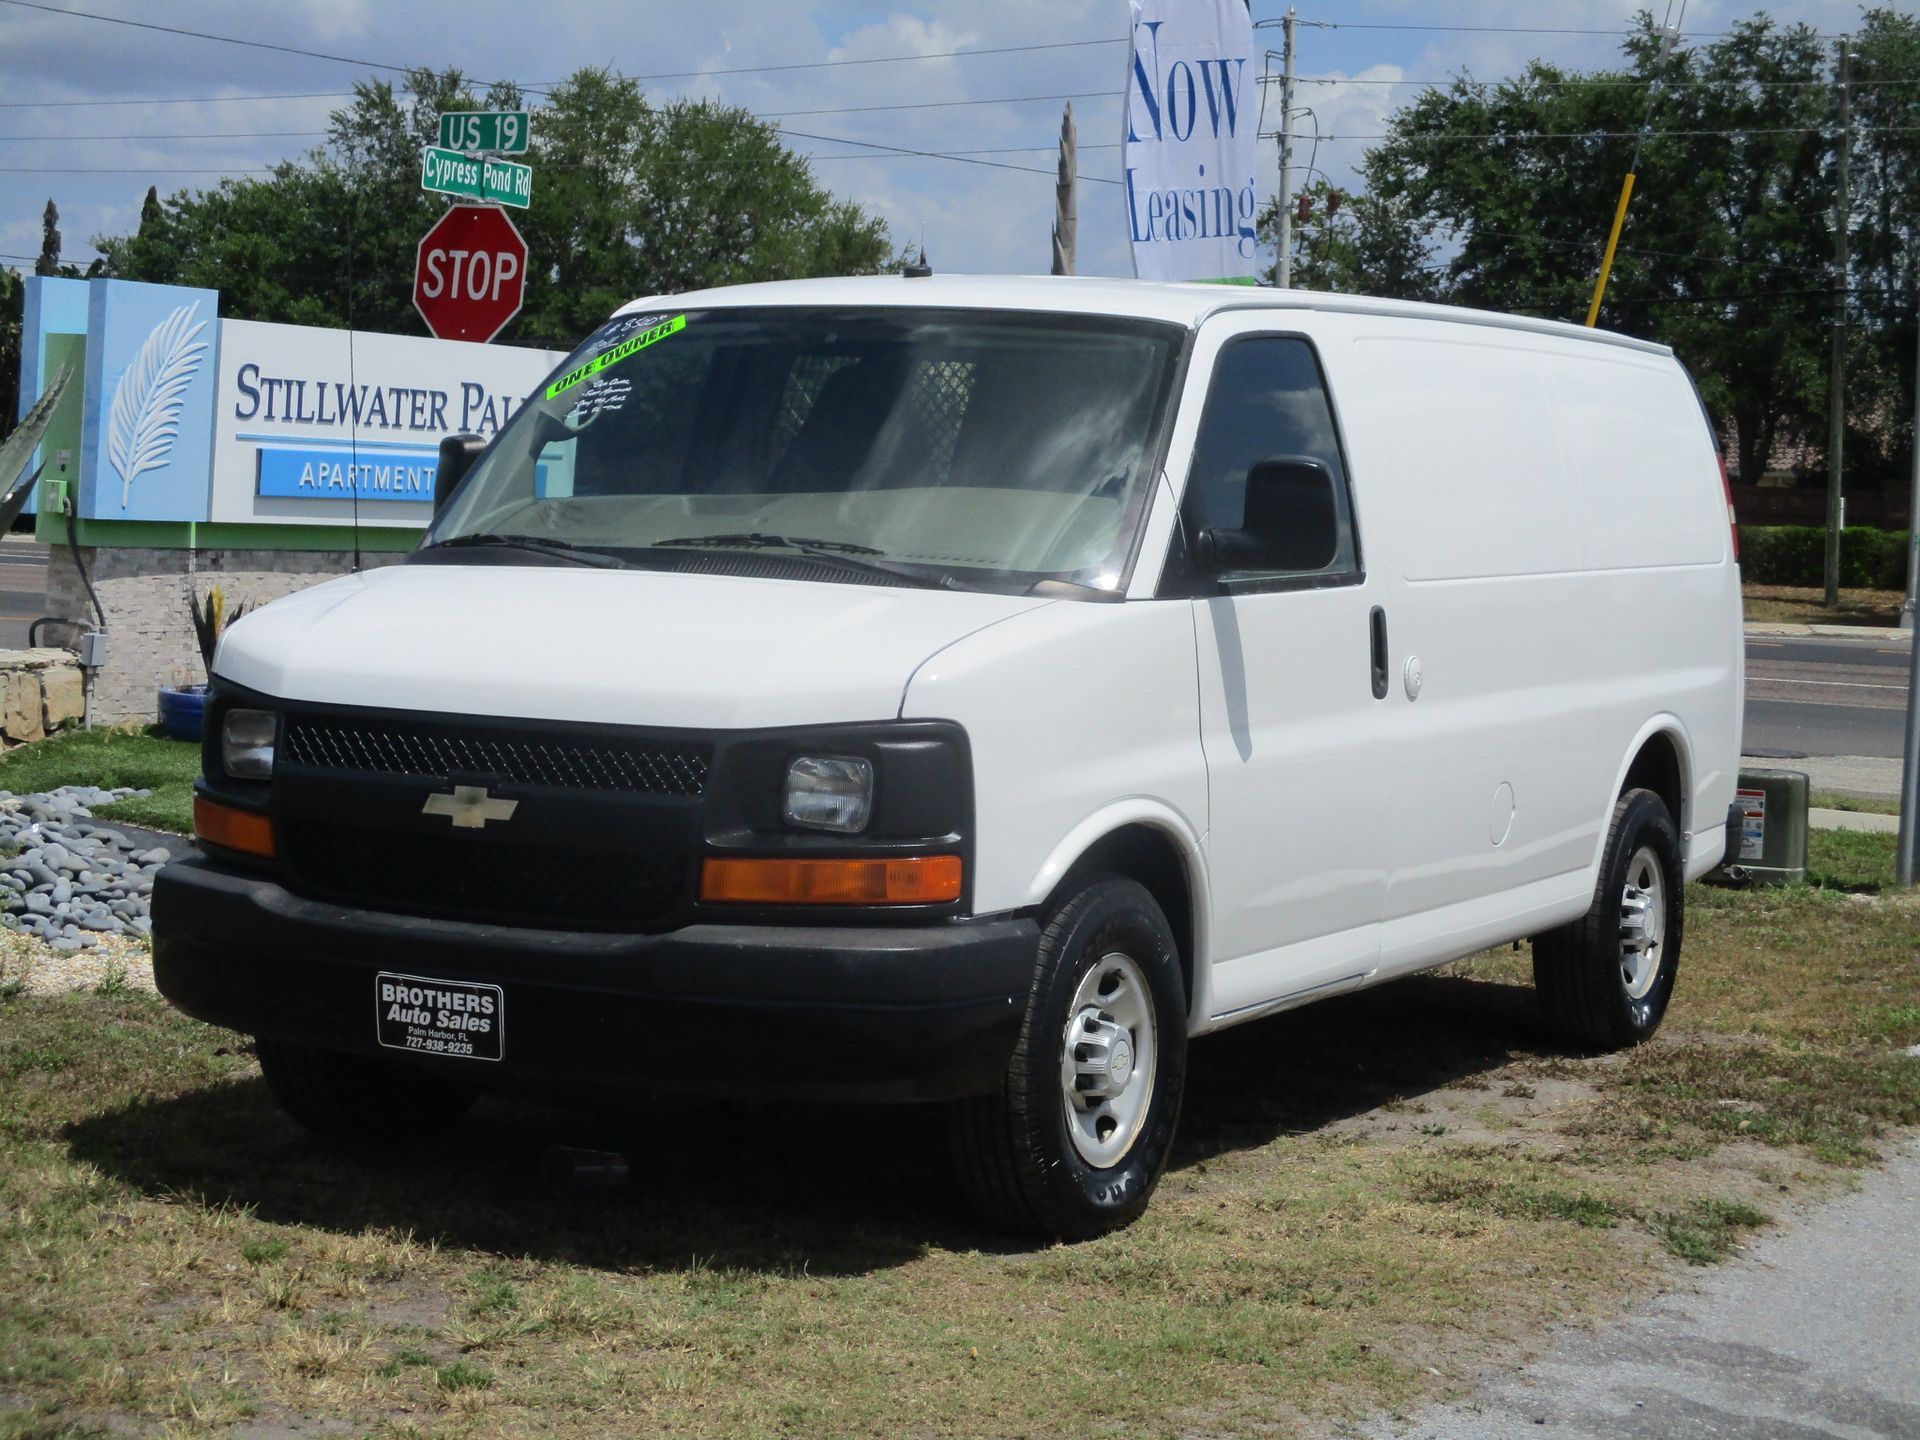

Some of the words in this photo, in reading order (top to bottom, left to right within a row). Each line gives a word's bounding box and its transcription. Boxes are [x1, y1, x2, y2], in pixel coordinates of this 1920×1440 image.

[448, 115, 481, 150] US
[495, 115, 519, 150] 19
[426, 151, 478, 187] Cypress
[483, 163, 511, 193] Pond
[515, 168, 530, 197] Rd
[1126, 164, 1257, 259] Leasing
[422, 248, 518, 301] STOP
[554, 363, 595, 393] ONE
[600, 320, 675, 367] OWNER
[235, 363, 448, 431] STILLWATER
[458, 382, 528, 434] PAL
[382, 983, 495, 1015] BROTHERS
[387, 1004, 431, 1026] Auto
[436, 1010, 491, 1033] Sales
[406, 1036, 473, 1055] 727-938-9235
[408, 1026, 427, 1036] Palm
[428, 1029, 457, 1041] Harbor,
[458, 1033, 469, 1042] FL
